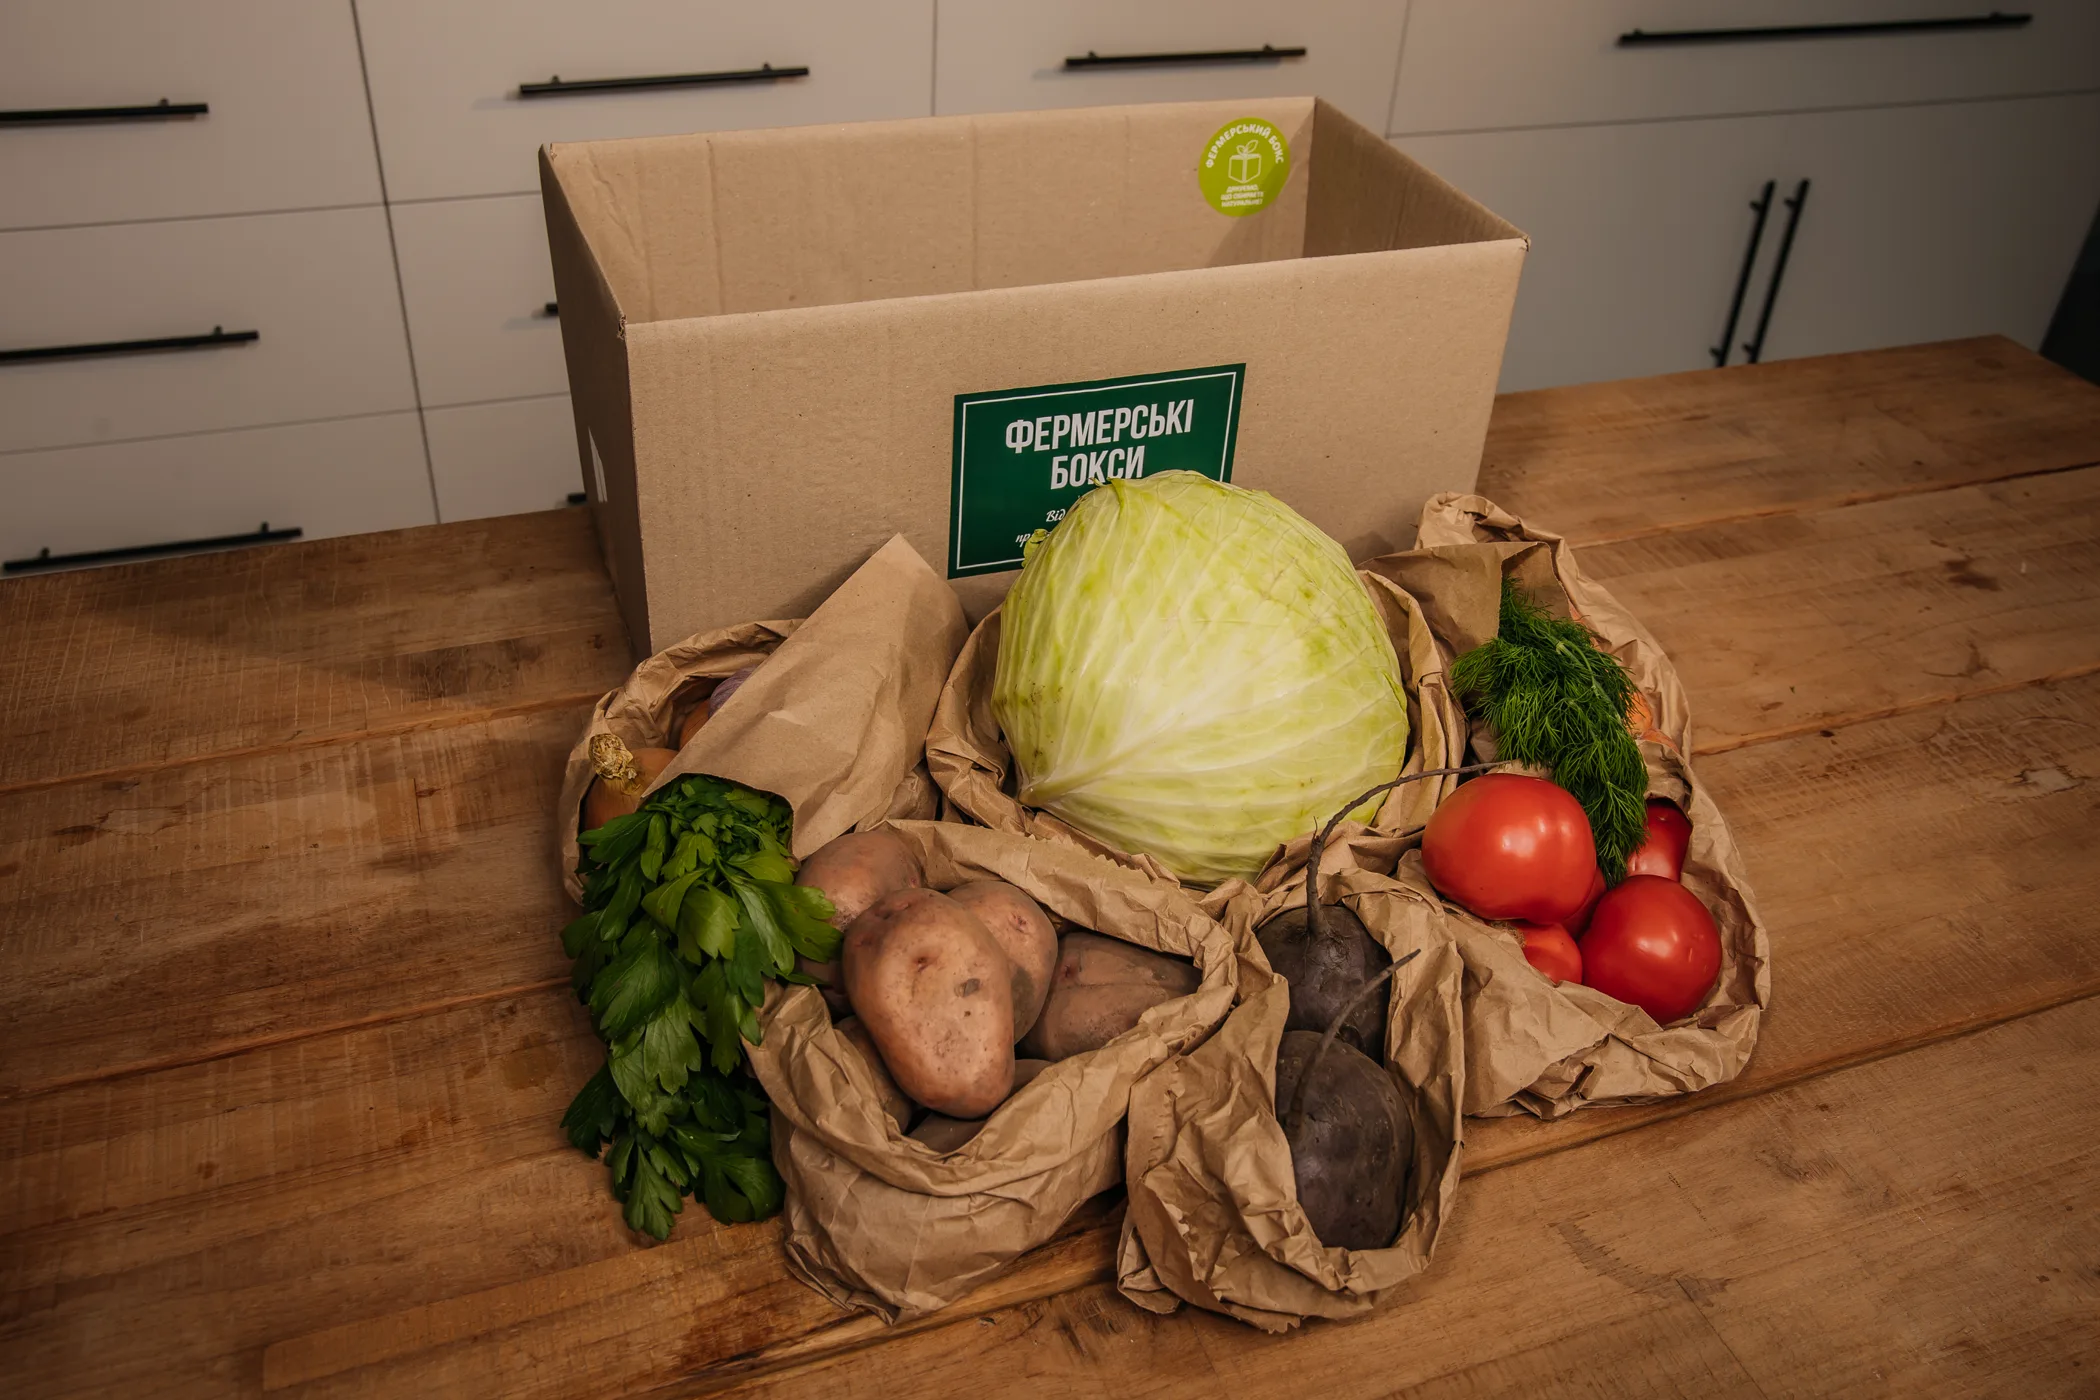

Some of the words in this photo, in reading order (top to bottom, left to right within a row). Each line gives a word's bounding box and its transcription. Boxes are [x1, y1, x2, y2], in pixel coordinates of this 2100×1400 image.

[1205, 124, 1272, 168] ФЕРМЕРСЬКИЙ
[1268, 135, 1284, 164] БОКС
[1005, 399, 1194, 454] ФЕРМЕРСЬКІ
[1050, 445, 1145, 490] БОКСИ
